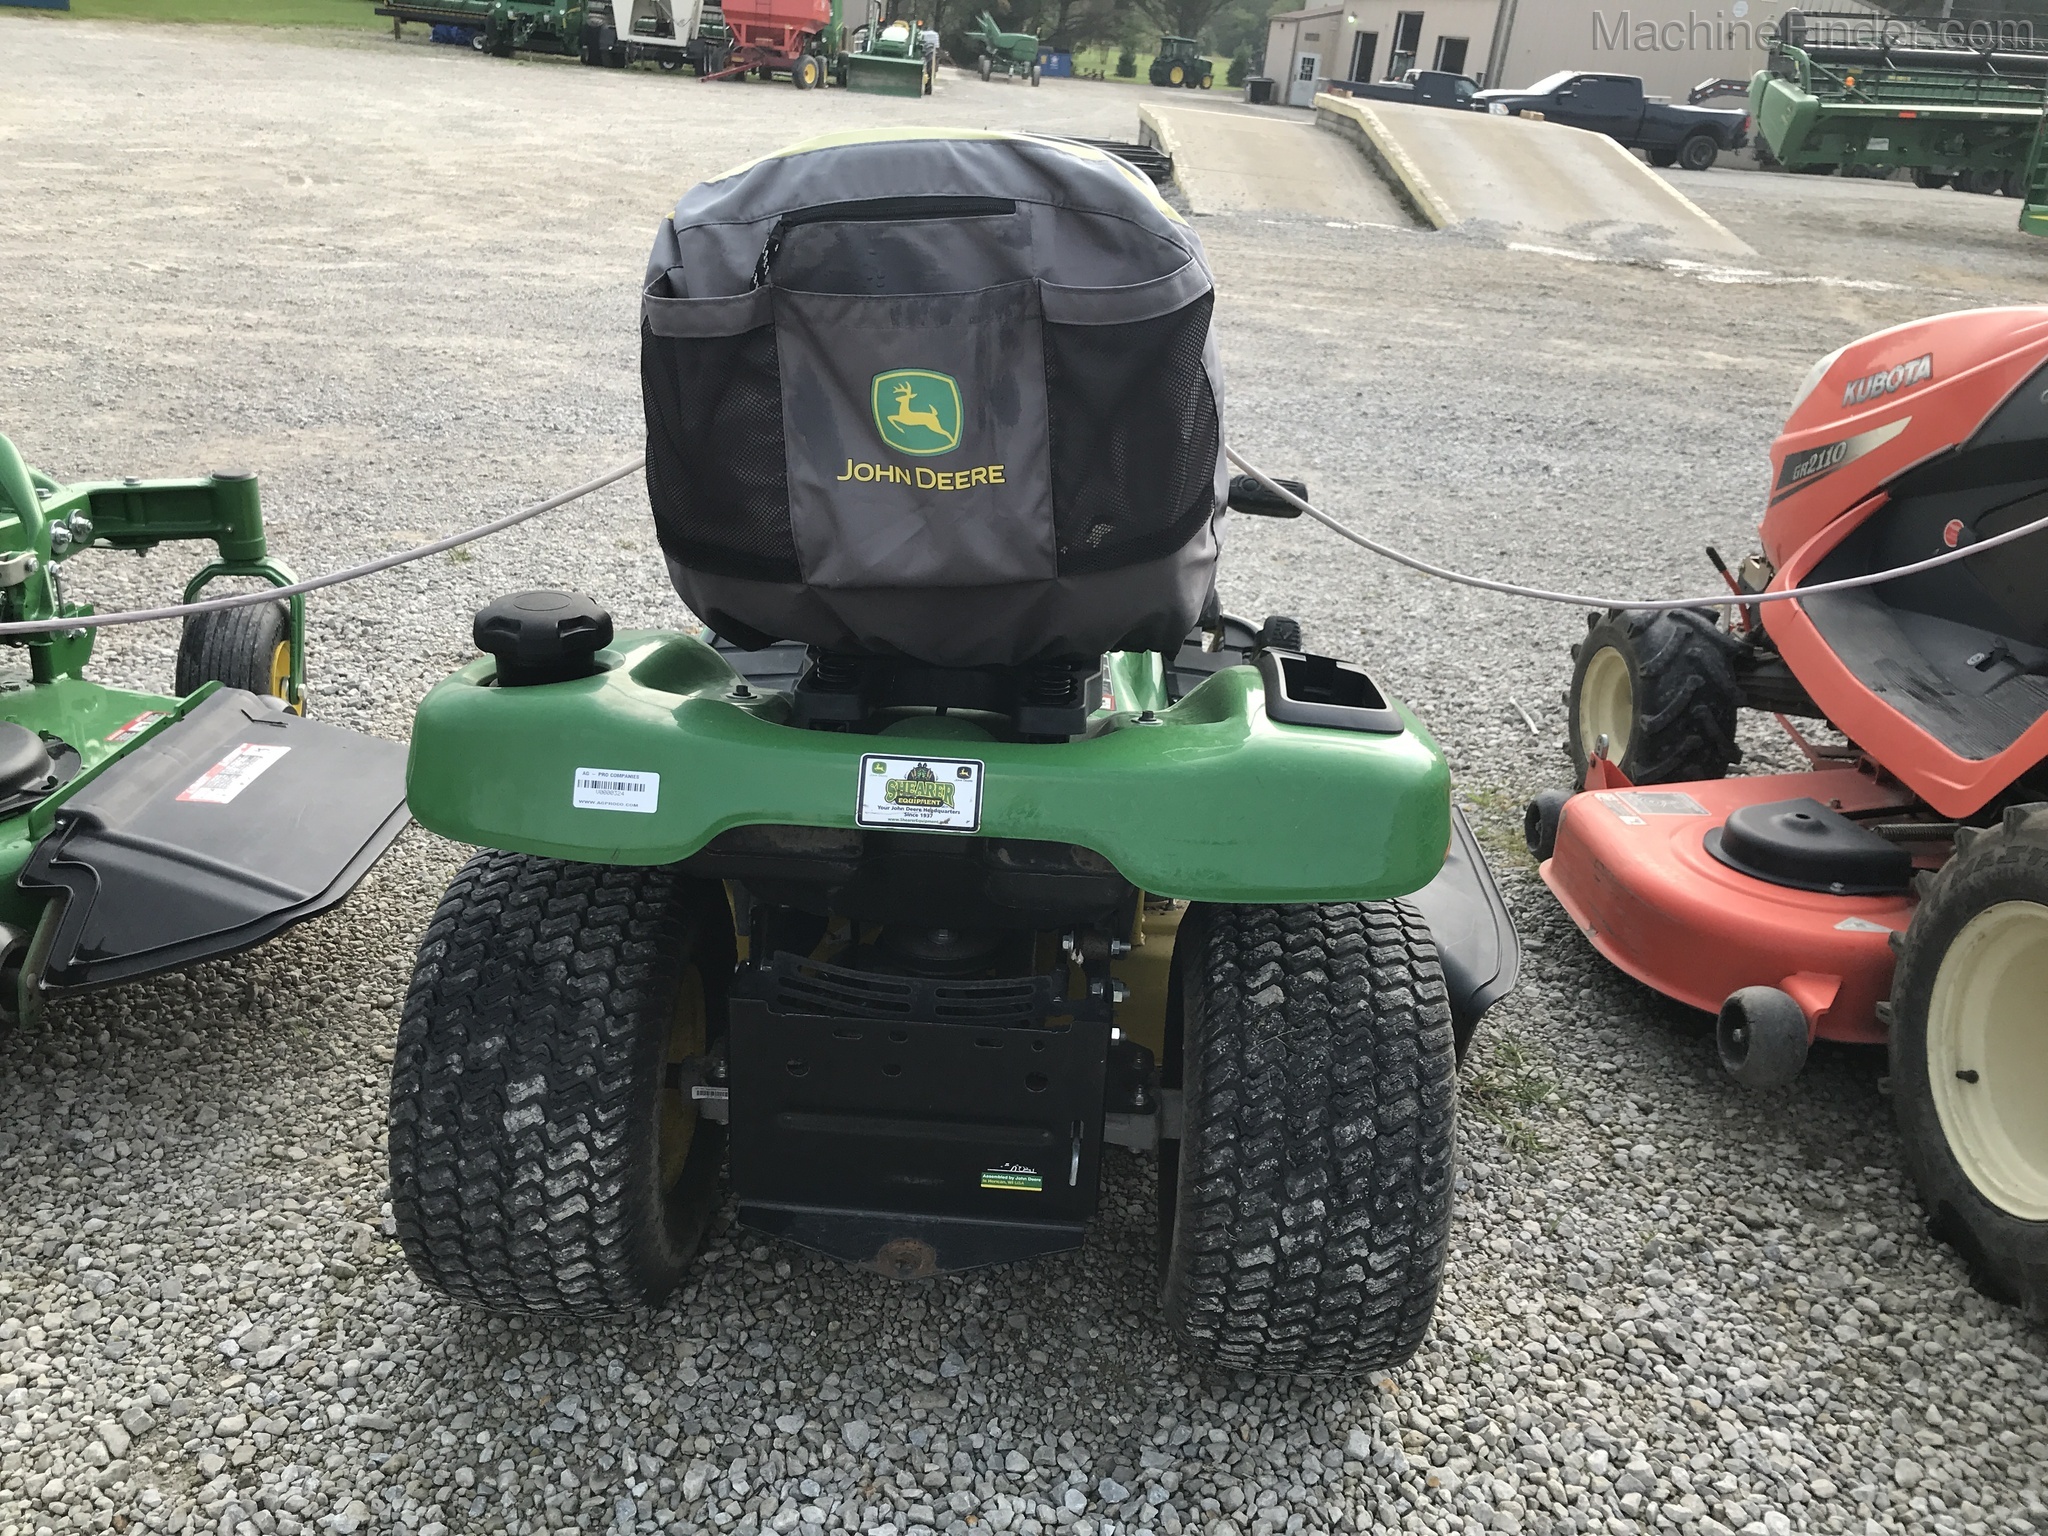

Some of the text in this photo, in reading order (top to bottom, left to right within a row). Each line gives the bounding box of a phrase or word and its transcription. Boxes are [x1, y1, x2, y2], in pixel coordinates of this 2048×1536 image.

[1842, 352, 1933, 408] KUBOTA
[836, 458, 1006, 491] JOHN DEERE
[1792, 441, 1847, 481] GR2110
[884, 778, 956, 809] SHEARER
[898, 797, 942, 806] EQUIPMENT
